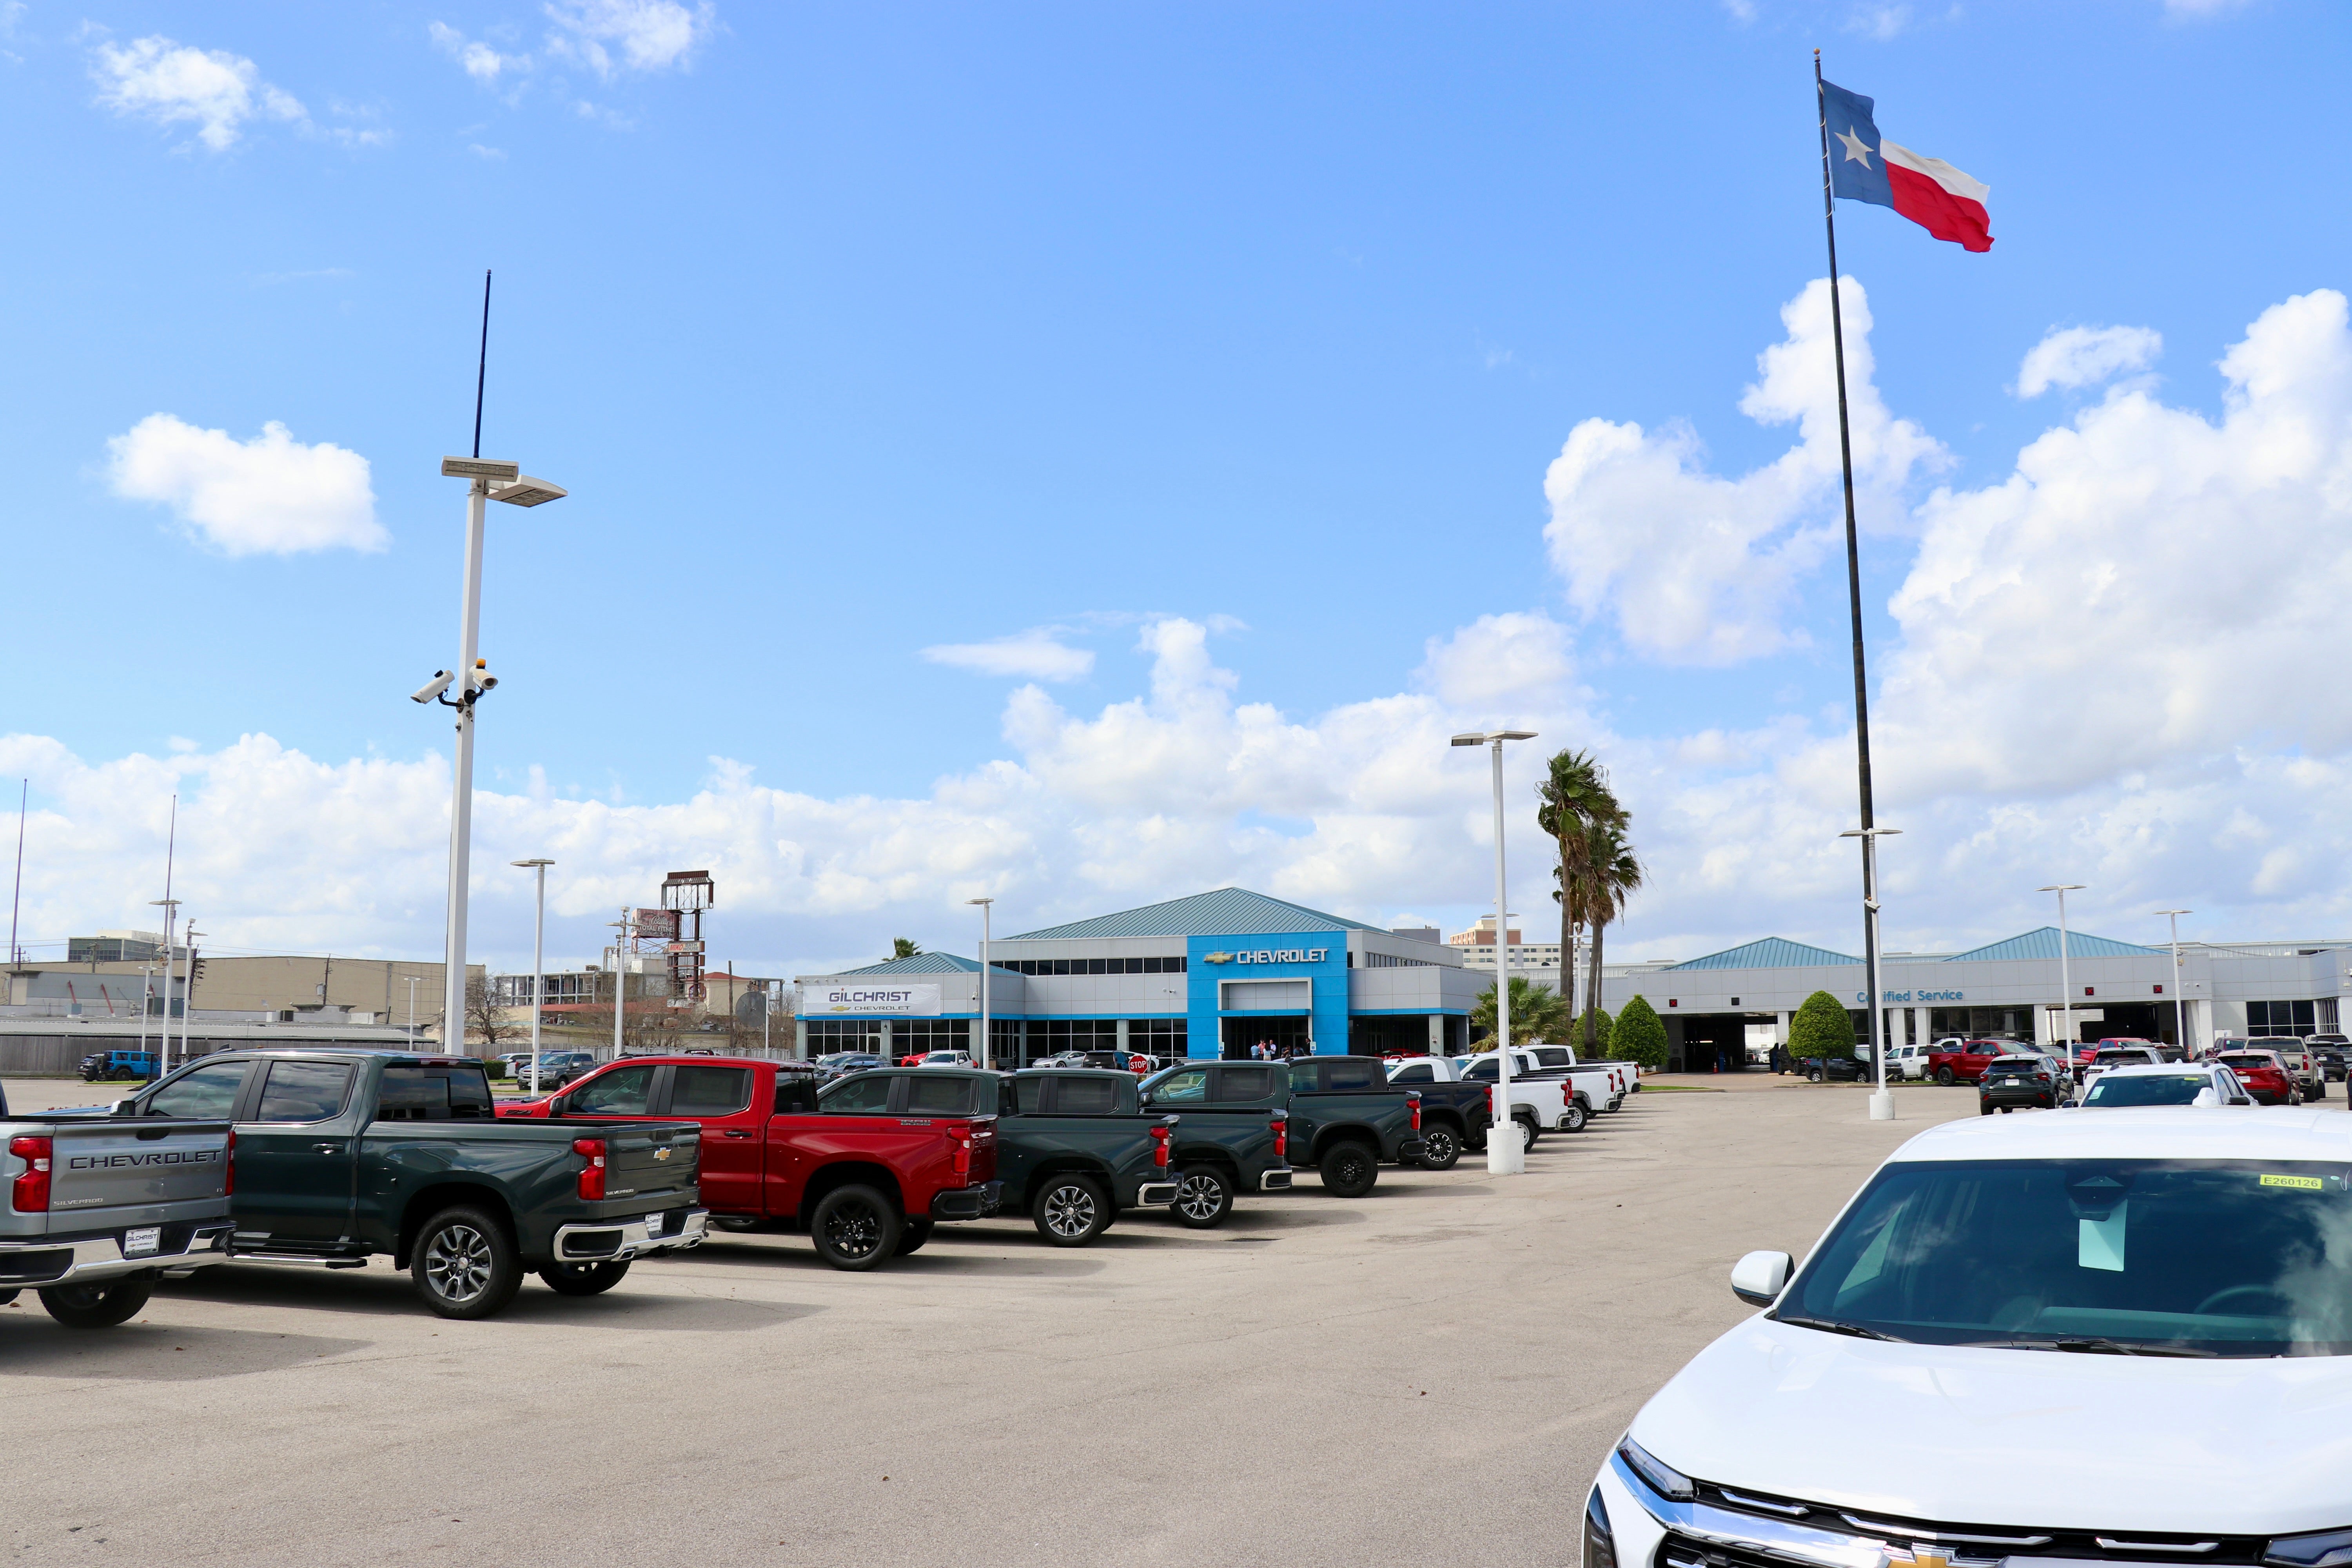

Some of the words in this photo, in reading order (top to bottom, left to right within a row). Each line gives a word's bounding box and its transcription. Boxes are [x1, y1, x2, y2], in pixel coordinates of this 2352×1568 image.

[1237, 949, 1328, 964] CHEVROLET
[829, 991, 912, 1002] GILCHRIST
[1917, 989, 1963, 1000] Service
[1130, 1060, 1146, 1069] STOP
[70, 1151, 221, 1170] CHEVROLET
[2264, 1177, 2318, 1187] E260126
